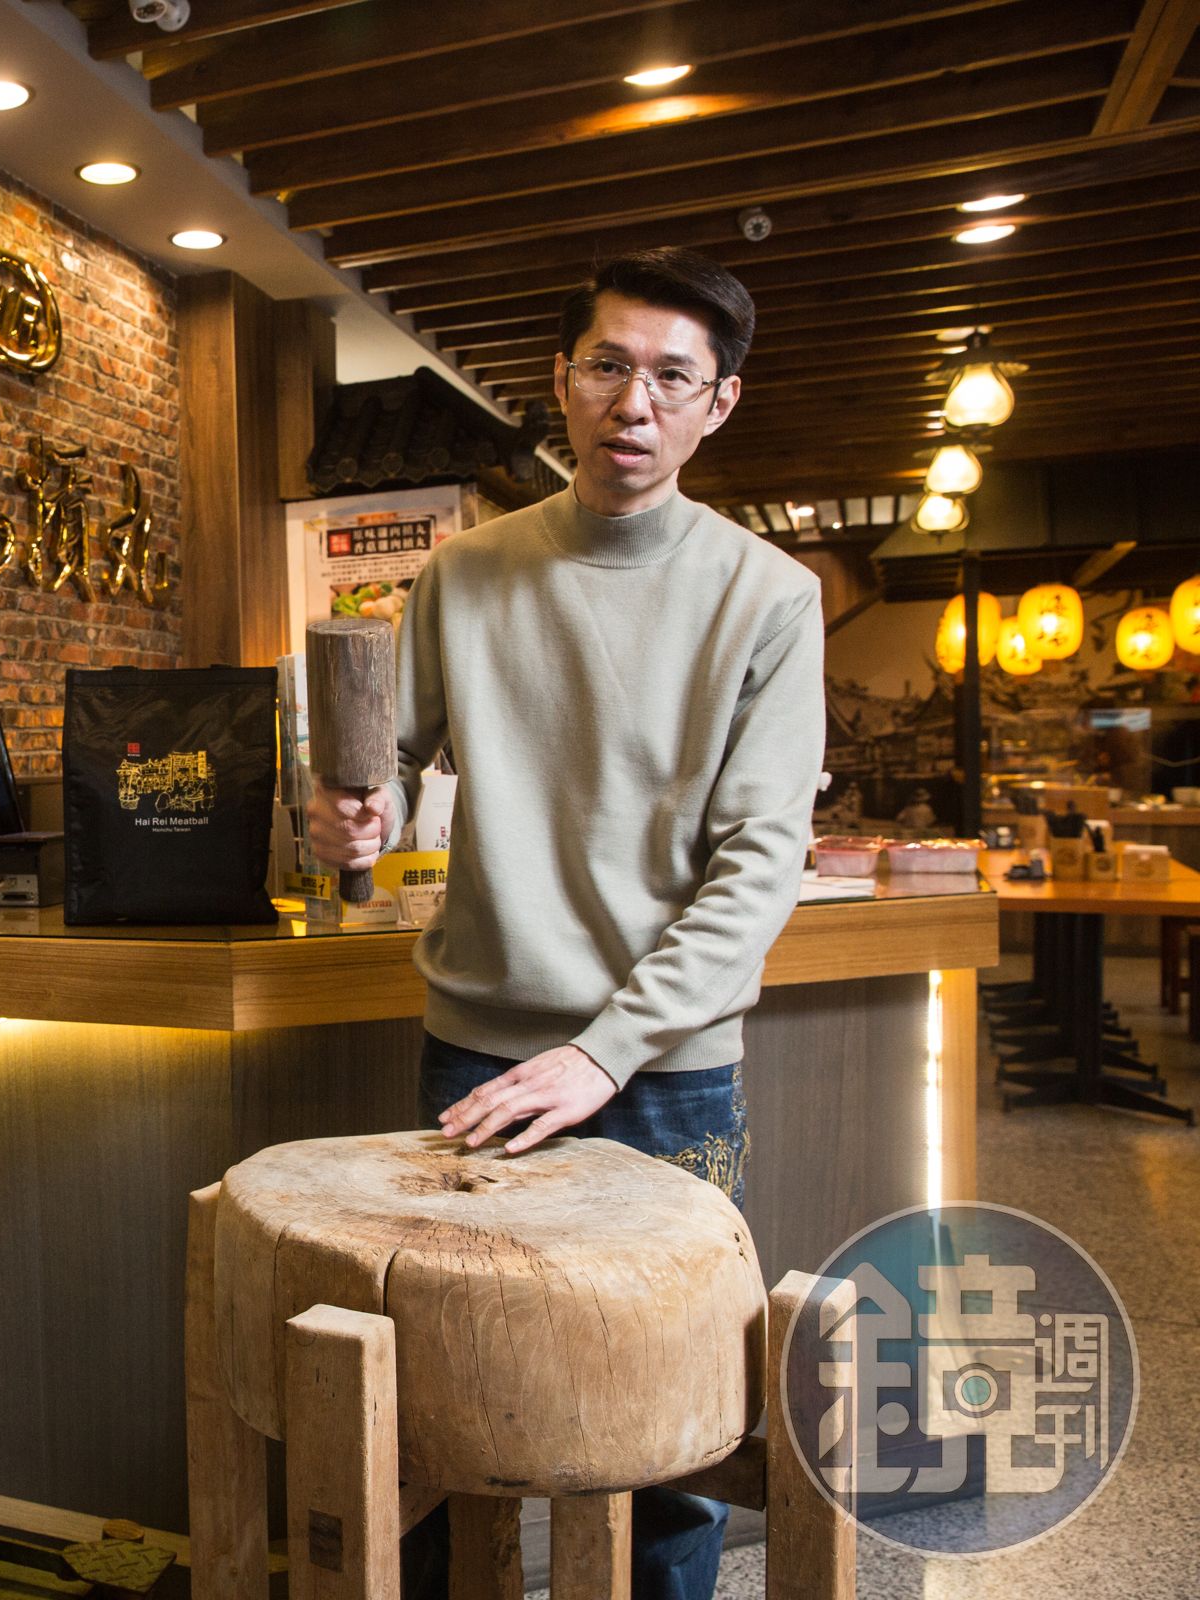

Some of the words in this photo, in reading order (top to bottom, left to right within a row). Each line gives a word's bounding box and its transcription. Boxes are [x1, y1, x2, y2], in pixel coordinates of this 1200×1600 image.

[135, 818, 150, 826] Hai
[152, 817, 168, 825] Rei
[169, 816, 209, 825] Meatball
